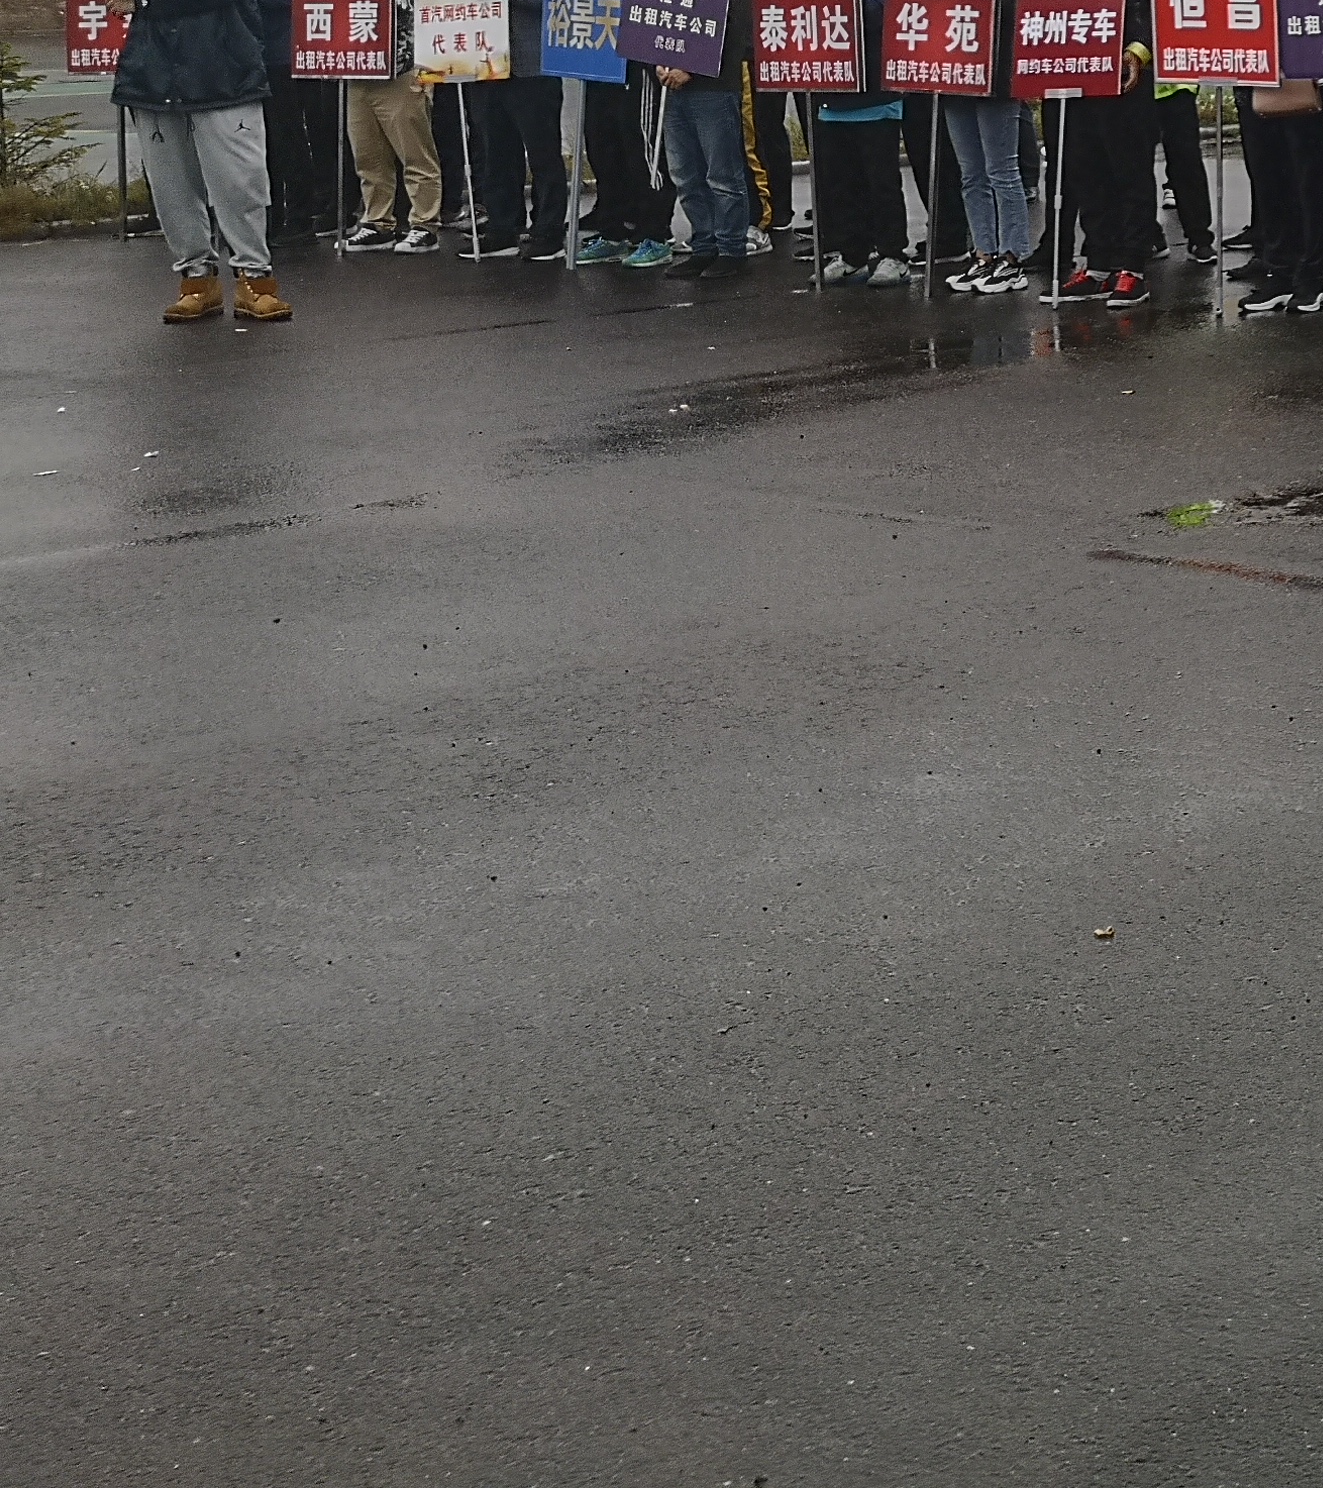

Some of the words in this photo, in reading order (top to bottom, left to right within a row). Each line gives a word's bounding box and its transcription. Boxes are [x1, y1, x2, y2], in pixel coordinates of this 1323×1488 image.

[303, 0, 379, 43] 西蒙
[419, 1, 502, 24] 首汽网约车公司
[629, 5, 717, 38] 出租汽车公司
[760, 5, 851, 52] 泰利达
[896, 3, 980, 53] 华苑
[1020, 9, 1117, 46] 神州专车
[432, 31, 490, 55] 代表队
[296, 50, 386, 70] 出租汽车公司代表队
[759, 61, 855, 84] 出租汽车公司代表队
[885, 59, 987, 86] 出租汽车公司代表队
[1017, 56, 1114, 75] 网约车公司代表队
[1163, 47, 1269, 74] 出租汽车公司代表队
